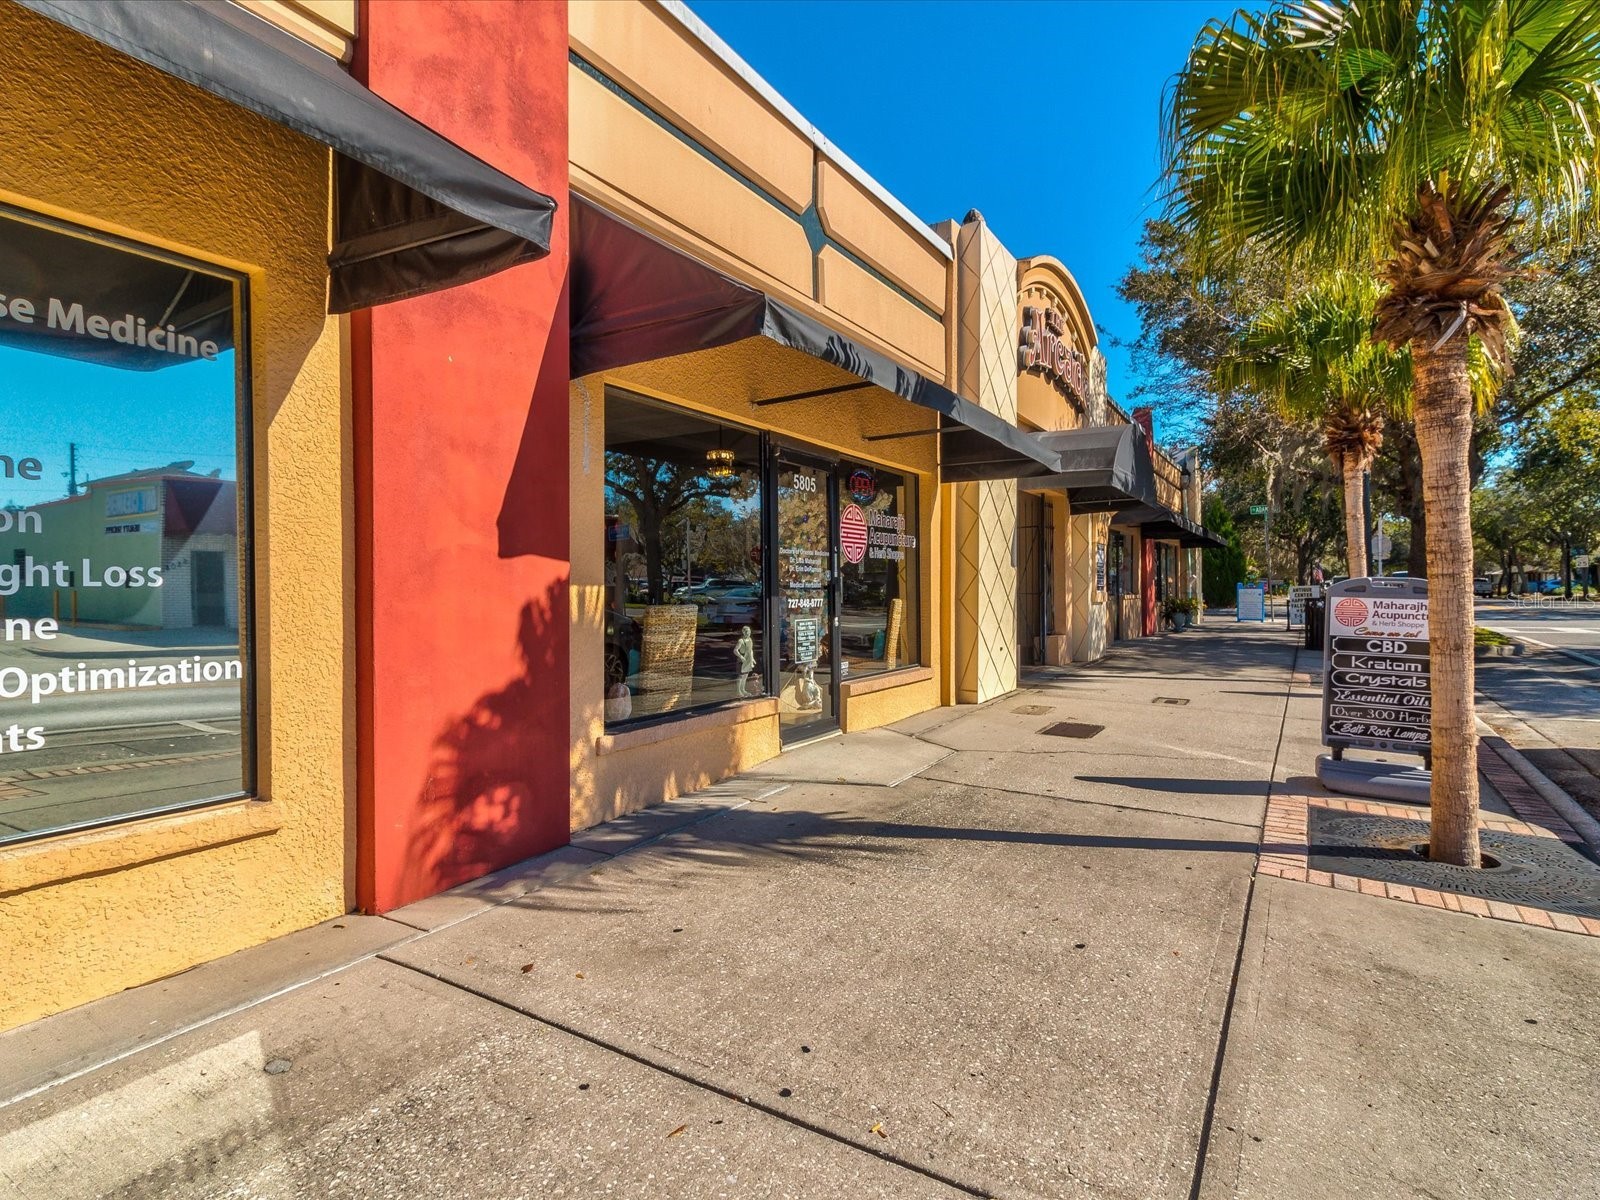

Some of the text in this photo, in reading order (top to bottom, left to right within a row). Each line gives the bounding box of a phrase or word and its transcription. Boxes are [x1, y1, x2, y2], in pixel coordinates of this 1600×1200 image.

[47, 298, 219, 361] Medicine
[793, 474, 816, 493] 5805
[869, 509, 906, 533] Maharajh
[869, 527, 916, 549] Acupuncture
[0, 556, 69, 596] ght
[82, 559, 163, 587] Loss
[1373, 601, 1428, 612] Maharajh
[1372, 610, 1429, 621] Acupunct
[5, 617, 59, 641] ne
[1354, 626, 1385, 637] Come
[1366, 640, 1407, 653] CBD
[1351, 656, 1422, 671] Kratom
[0, 655, 243, 703] Optimization
[1345, 673, 1427, 687] Crystals
[1340, 690, 1429, 706] Essential Oils
[1335, 706, 1363, 717] Over
[1366, 708, 1395, 720] 300
[0, 724, 45, 752] ts
[1340, 723, 1428, 740] Salt Rock Lamps
